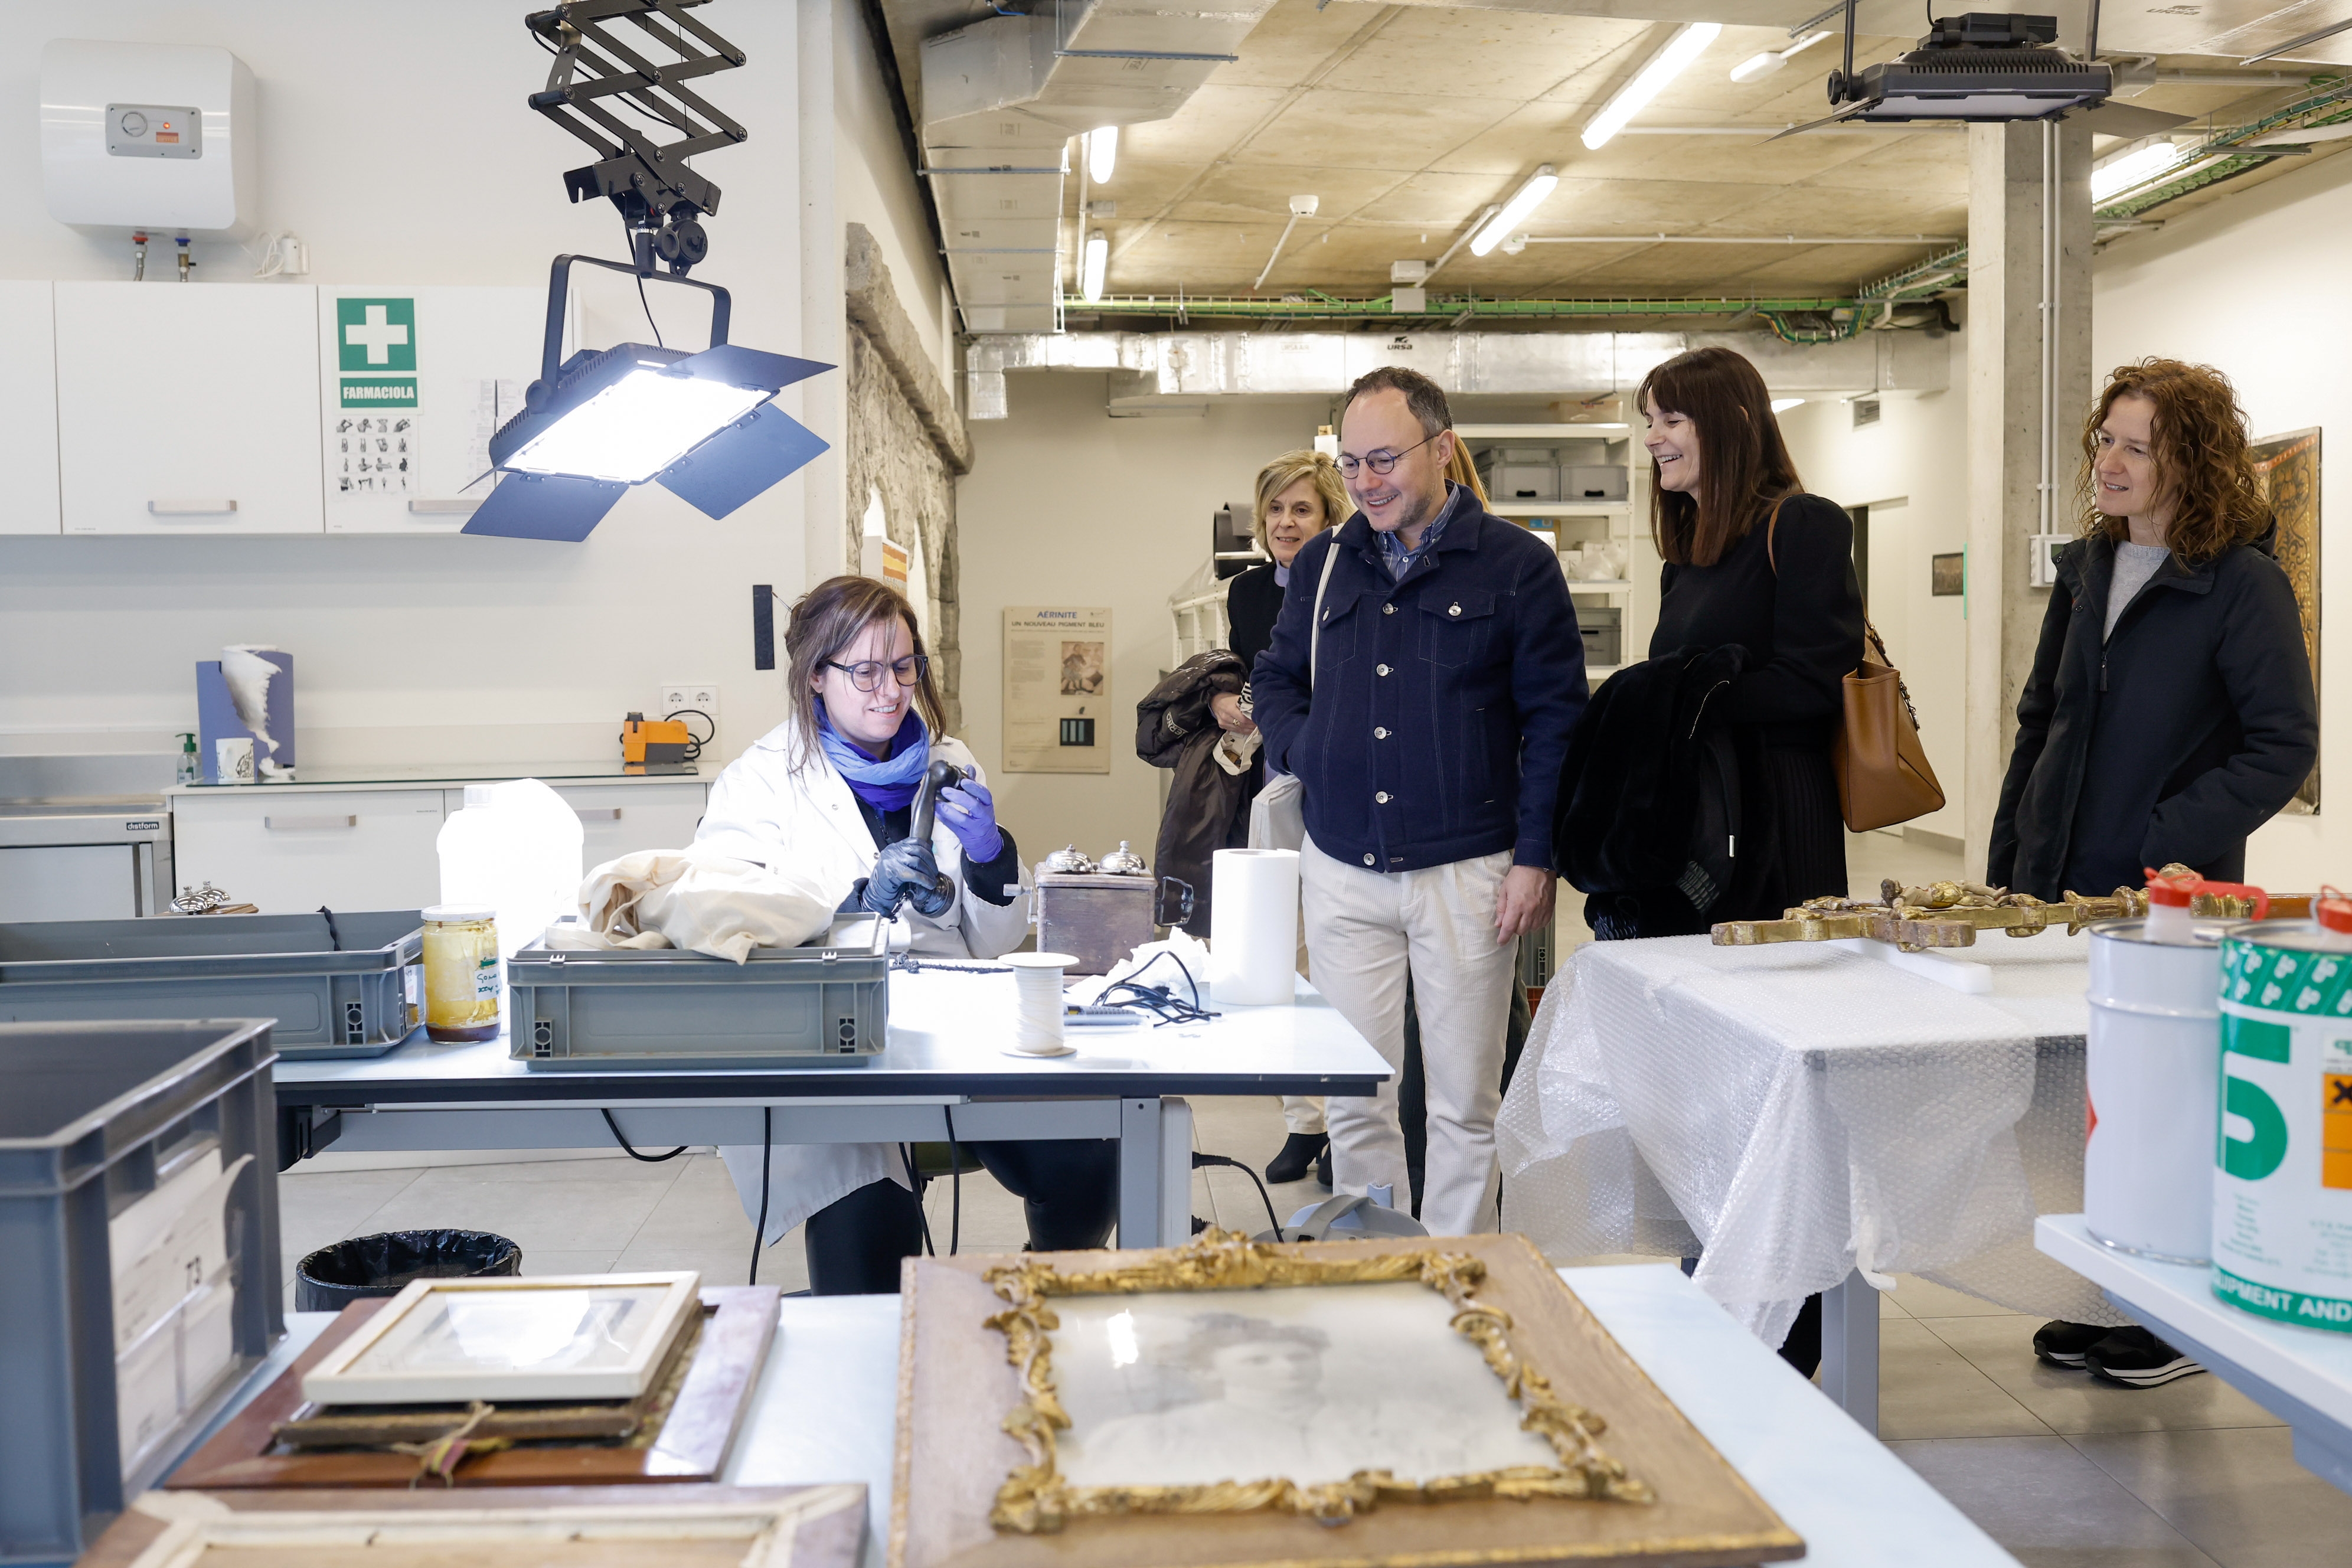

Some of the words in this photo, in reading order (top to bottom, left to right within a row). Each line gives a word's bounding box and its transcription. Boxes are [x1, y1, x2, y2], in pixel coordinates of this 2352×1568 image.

[343, 386, 414, 399] FARMACIOLA
[1037, 610, 1077, 619] AÉRINITE
[2298, 1298, 2352, 1322] AND
